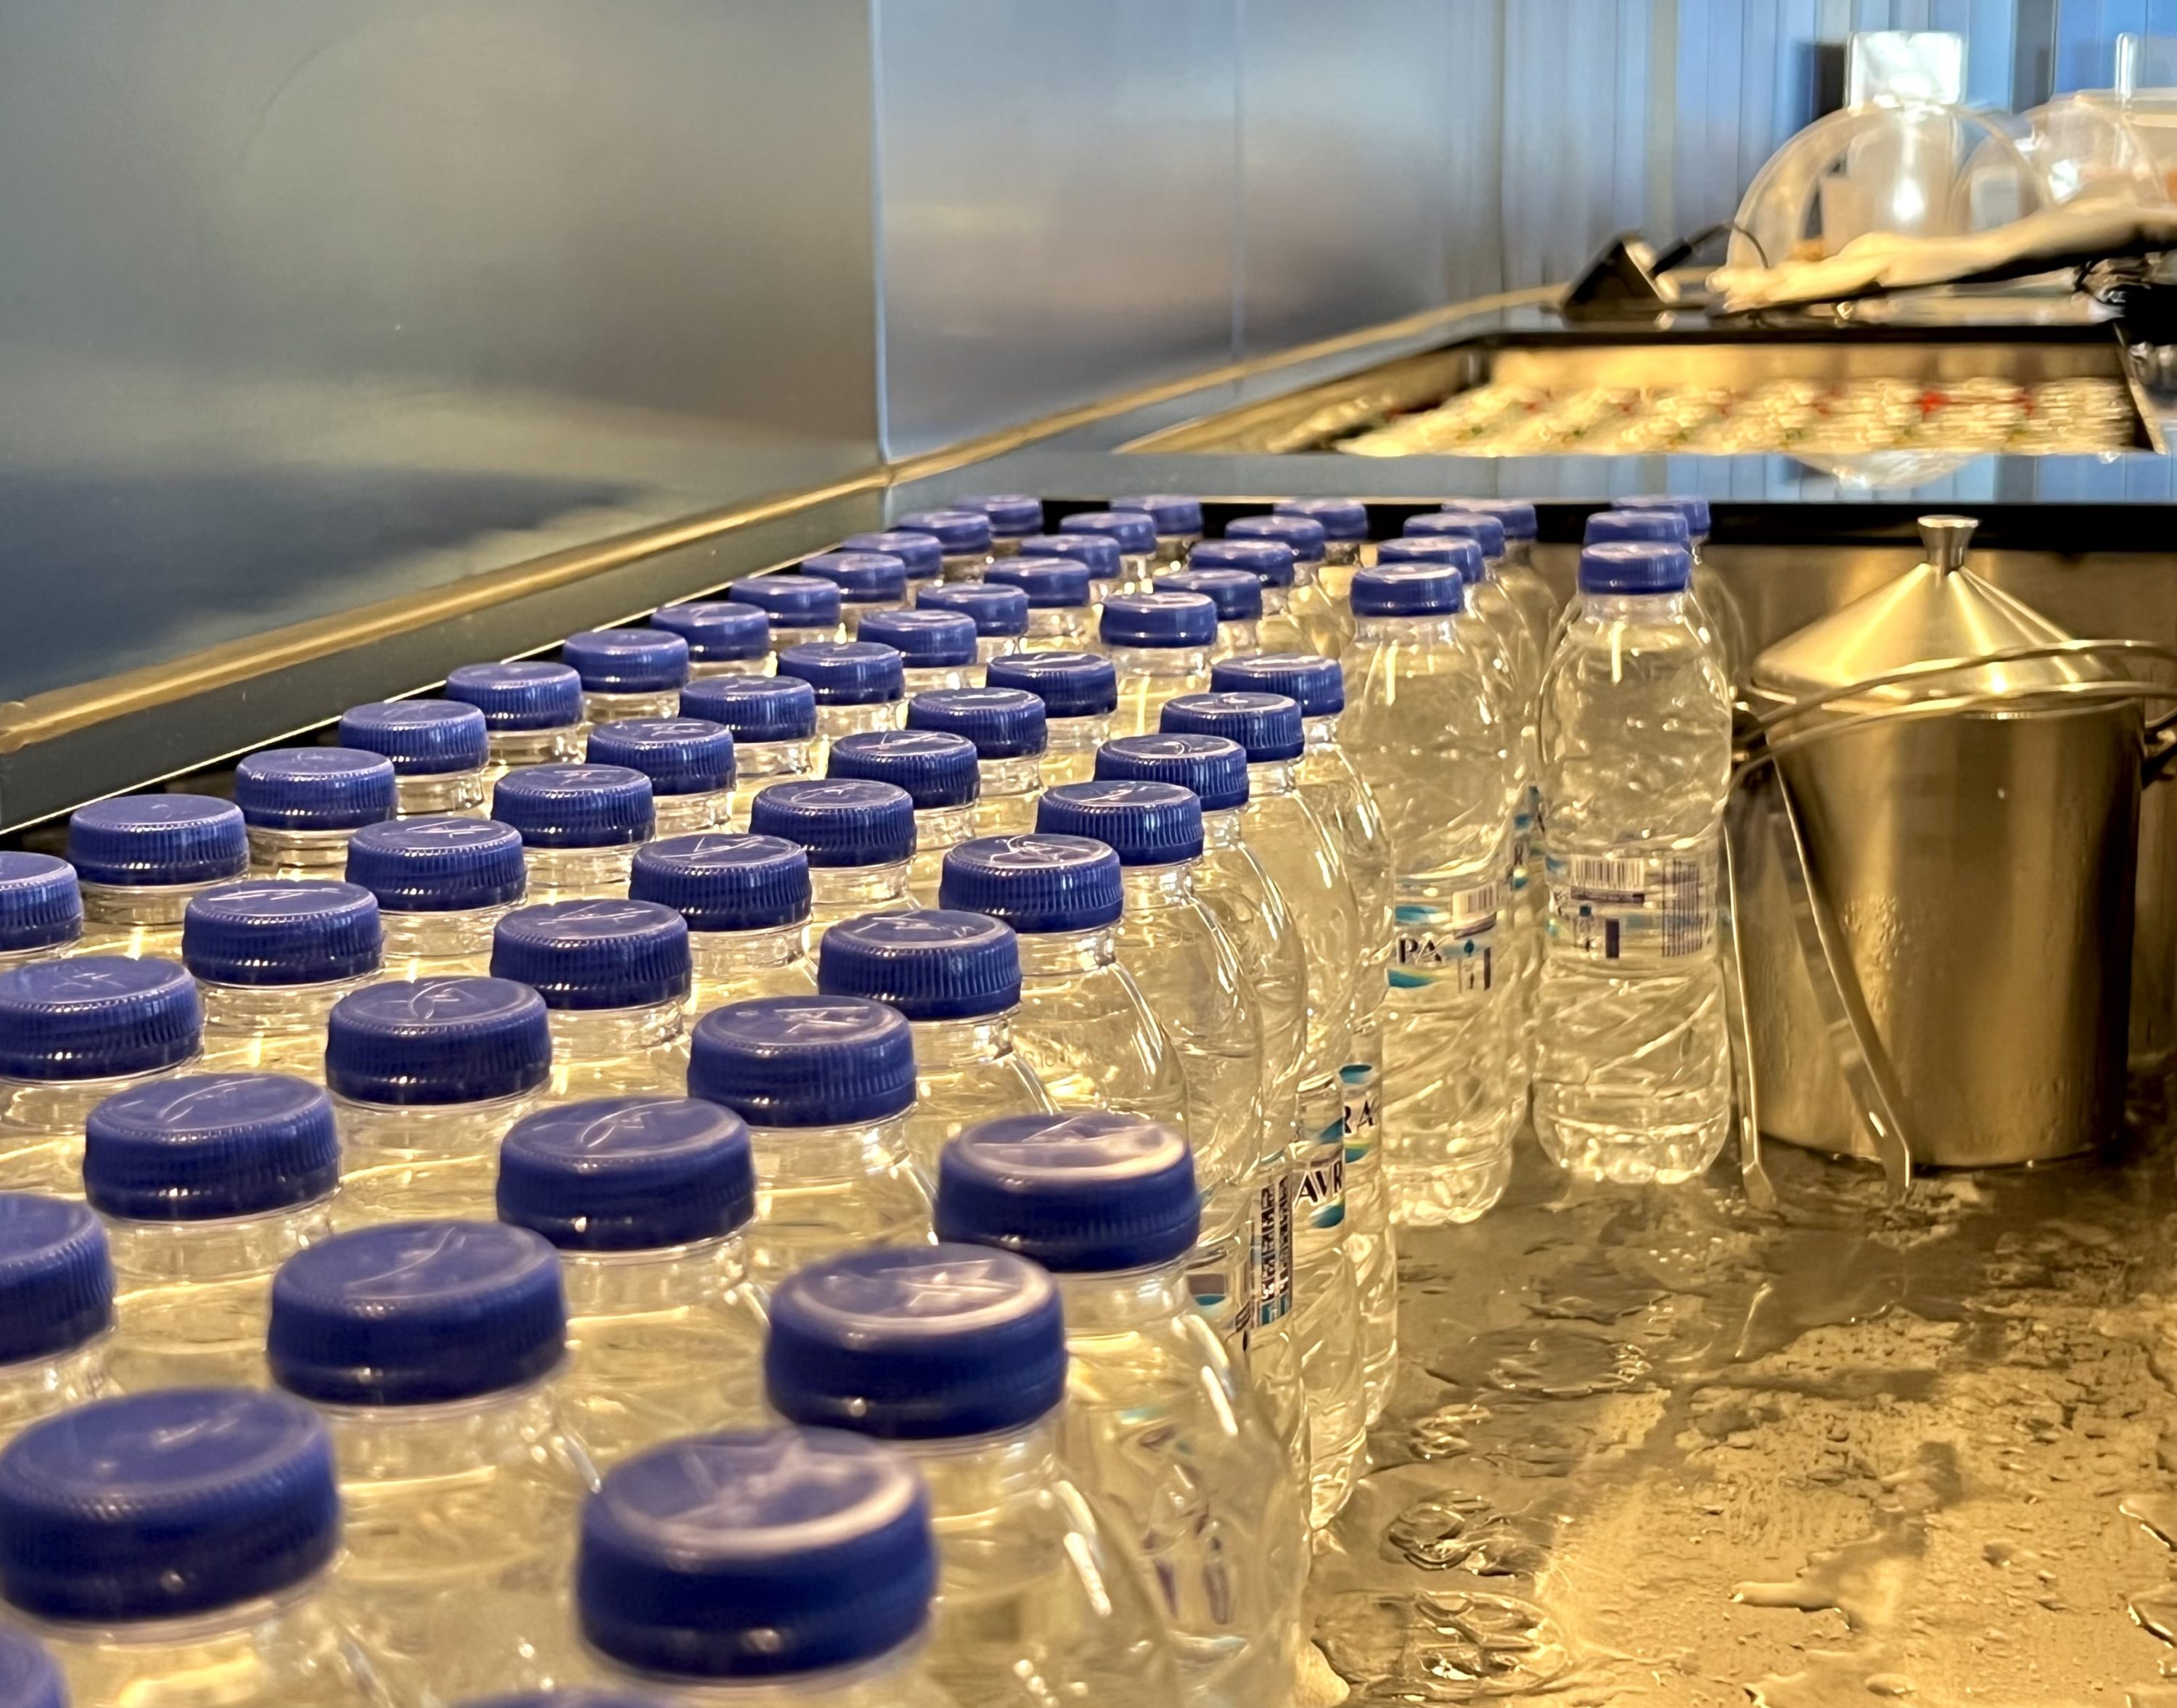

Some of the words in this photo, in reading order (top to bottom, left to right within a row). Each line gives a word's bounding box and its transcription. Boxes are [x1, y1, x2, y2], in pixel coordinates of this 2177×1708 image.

[1399, 937, 1443, 964] PA
[1343, 1099, 1374, 1134] RA
[1295, 1161, 1342, 1207] AVR
